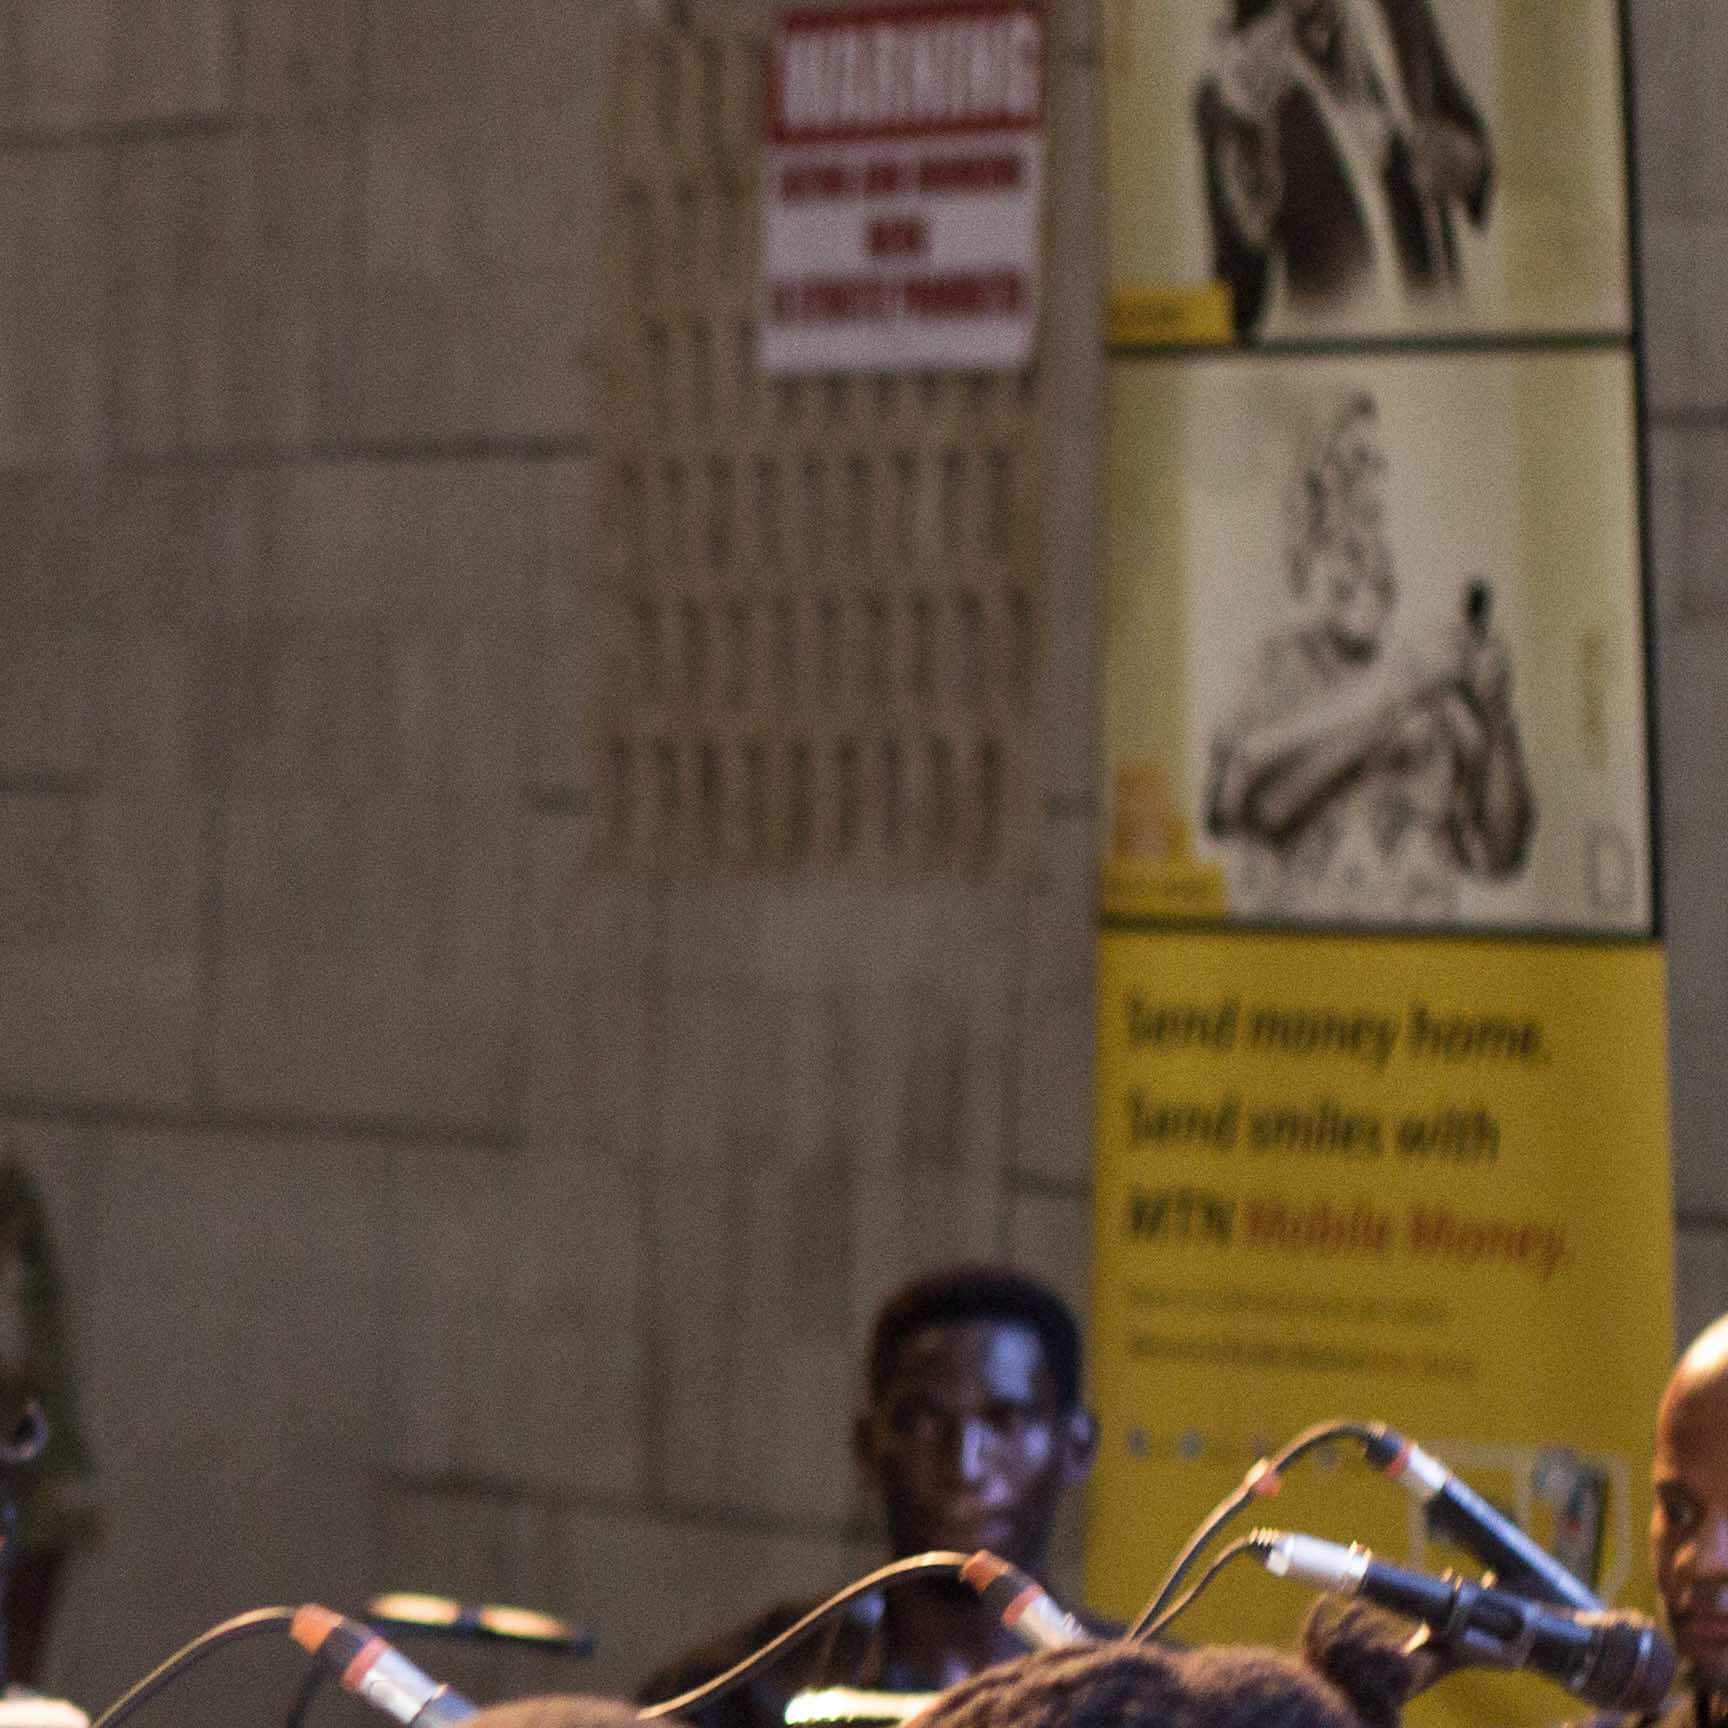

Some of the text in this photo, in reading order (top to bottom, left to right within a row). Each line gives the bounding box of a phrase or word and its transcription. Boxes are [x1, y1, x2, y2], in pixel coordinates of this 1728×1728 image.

[784, 15, 1041, 126] WARNING
[1126, 993, 1238, 1051] Send
[1248, 1006, 1397, 1071] money
[1126, 1090, 1501, 1162] Send smiles with
[1127, 1189, 1234, 1244] MTN
[1245, 1197, 1393, 1252] Mobile
